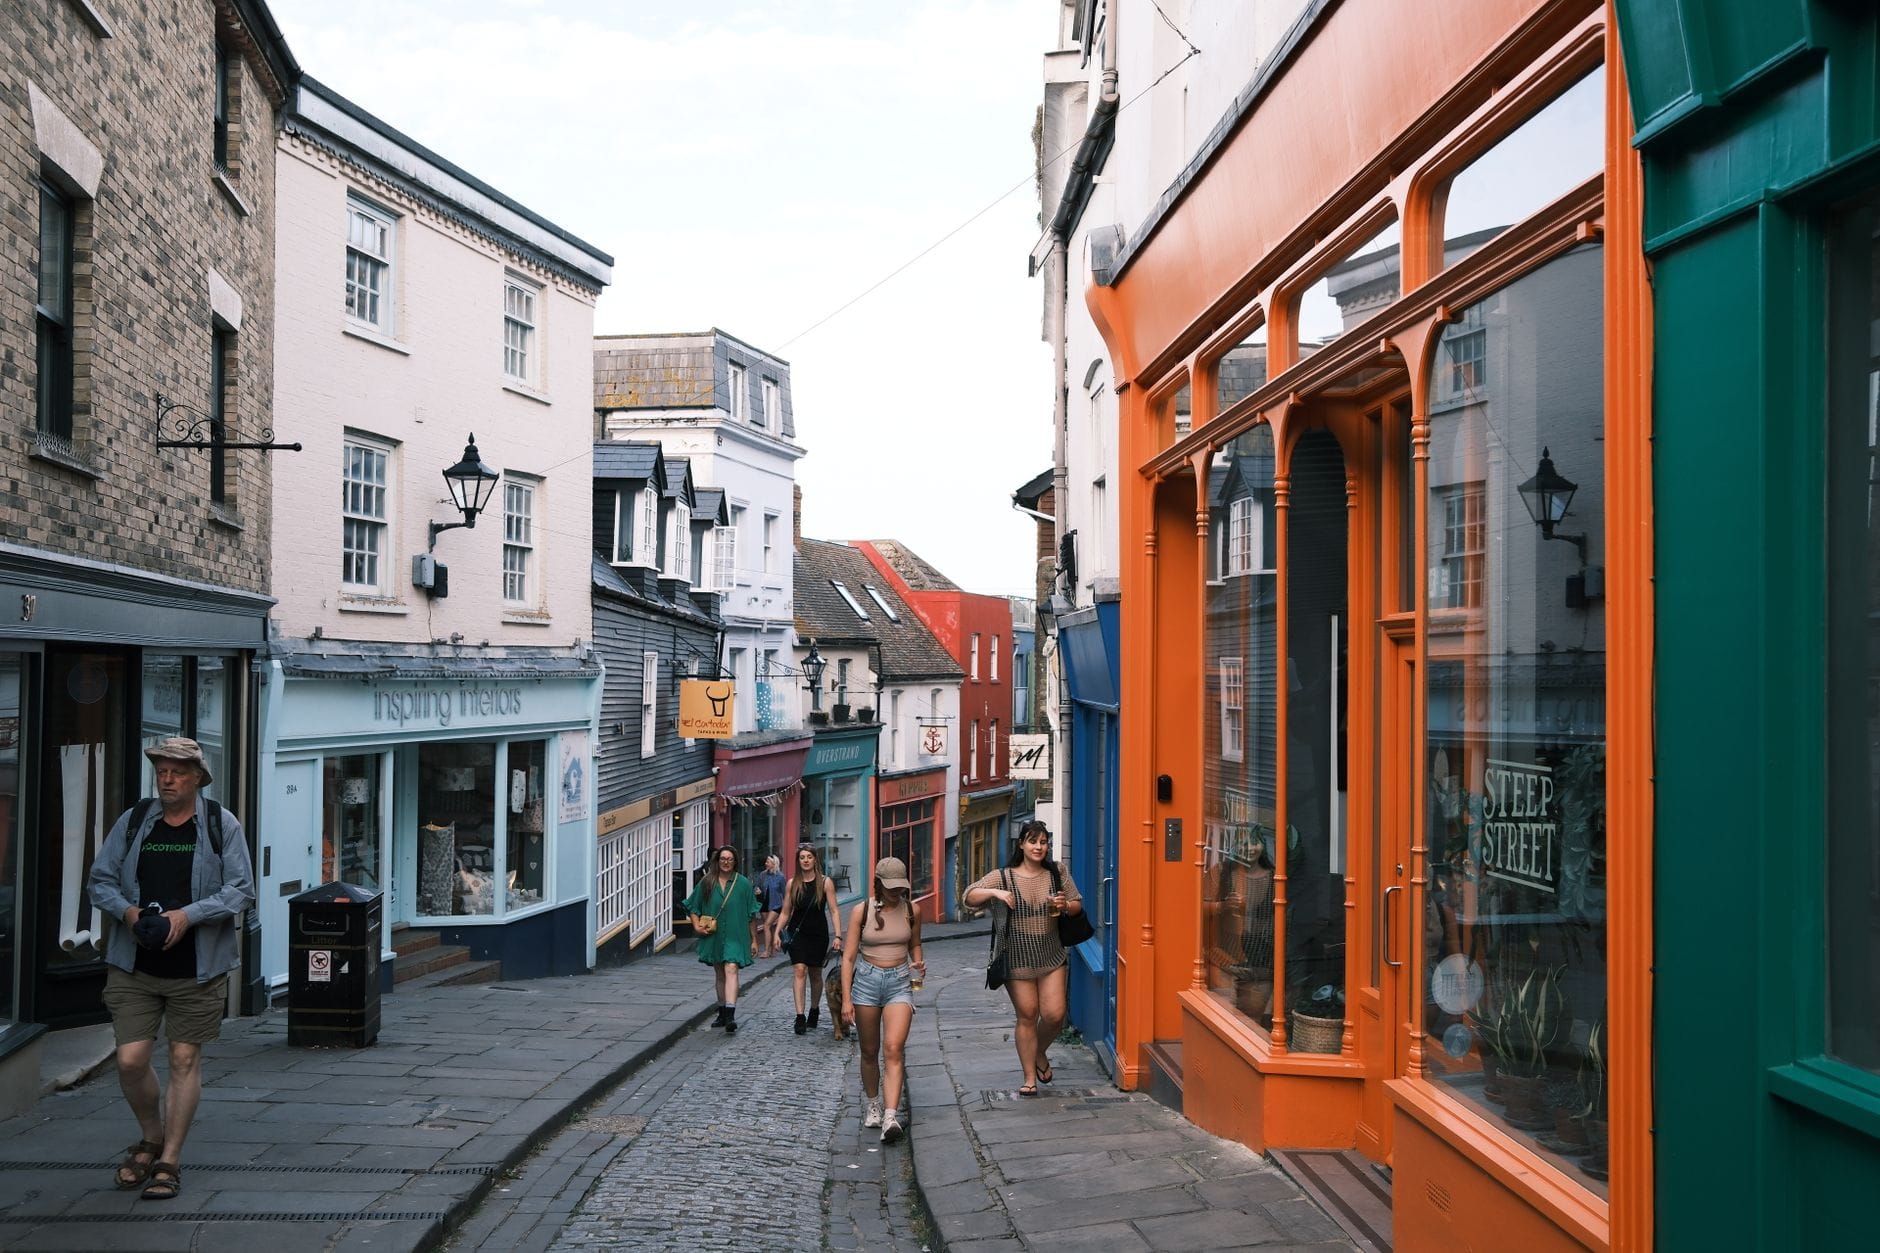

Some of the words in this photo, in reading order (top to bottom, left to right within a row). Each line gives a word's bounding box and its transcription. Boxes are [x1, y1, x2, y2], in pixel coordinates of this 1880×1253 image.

[374, 682, 452, 727] inspiring
[460, 682, 521, 716] interiors
[816, 745, 860, 764] OVERSTRAND
[1483, 768, 1554, 820] STEEP
[1482, 822, 1556, 881] STREET
